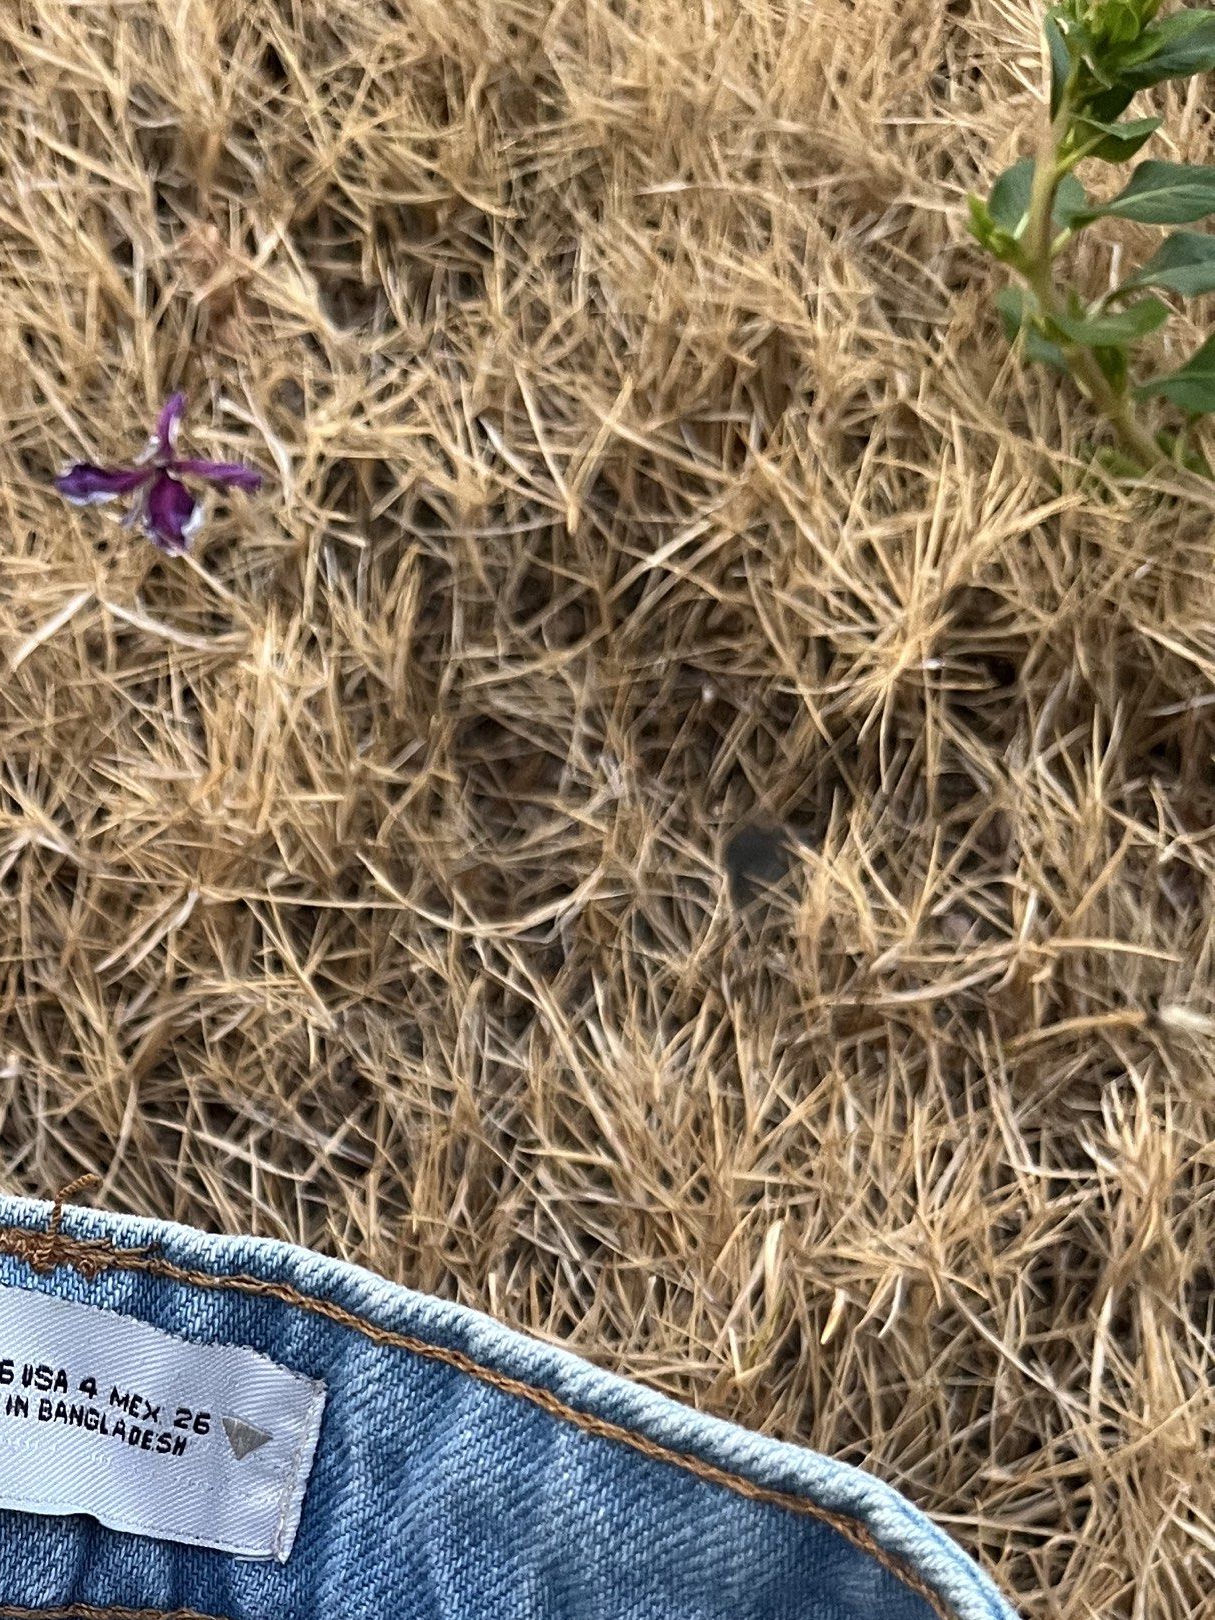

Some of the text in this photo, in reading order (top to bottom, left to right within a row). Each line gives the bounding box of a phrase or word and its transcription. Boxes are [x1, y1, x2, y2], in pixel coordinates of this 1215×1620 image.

[5, 1393, 29, 1419] IN
[37, 1397, 187, 1457] BANGLADESH
[21, 1363, 68, 1394] USA
[78, 1376, 98, 1400] 4
[108, 1385, 161, 1423] MEX
[173, 1406, 212, 1436] 26
